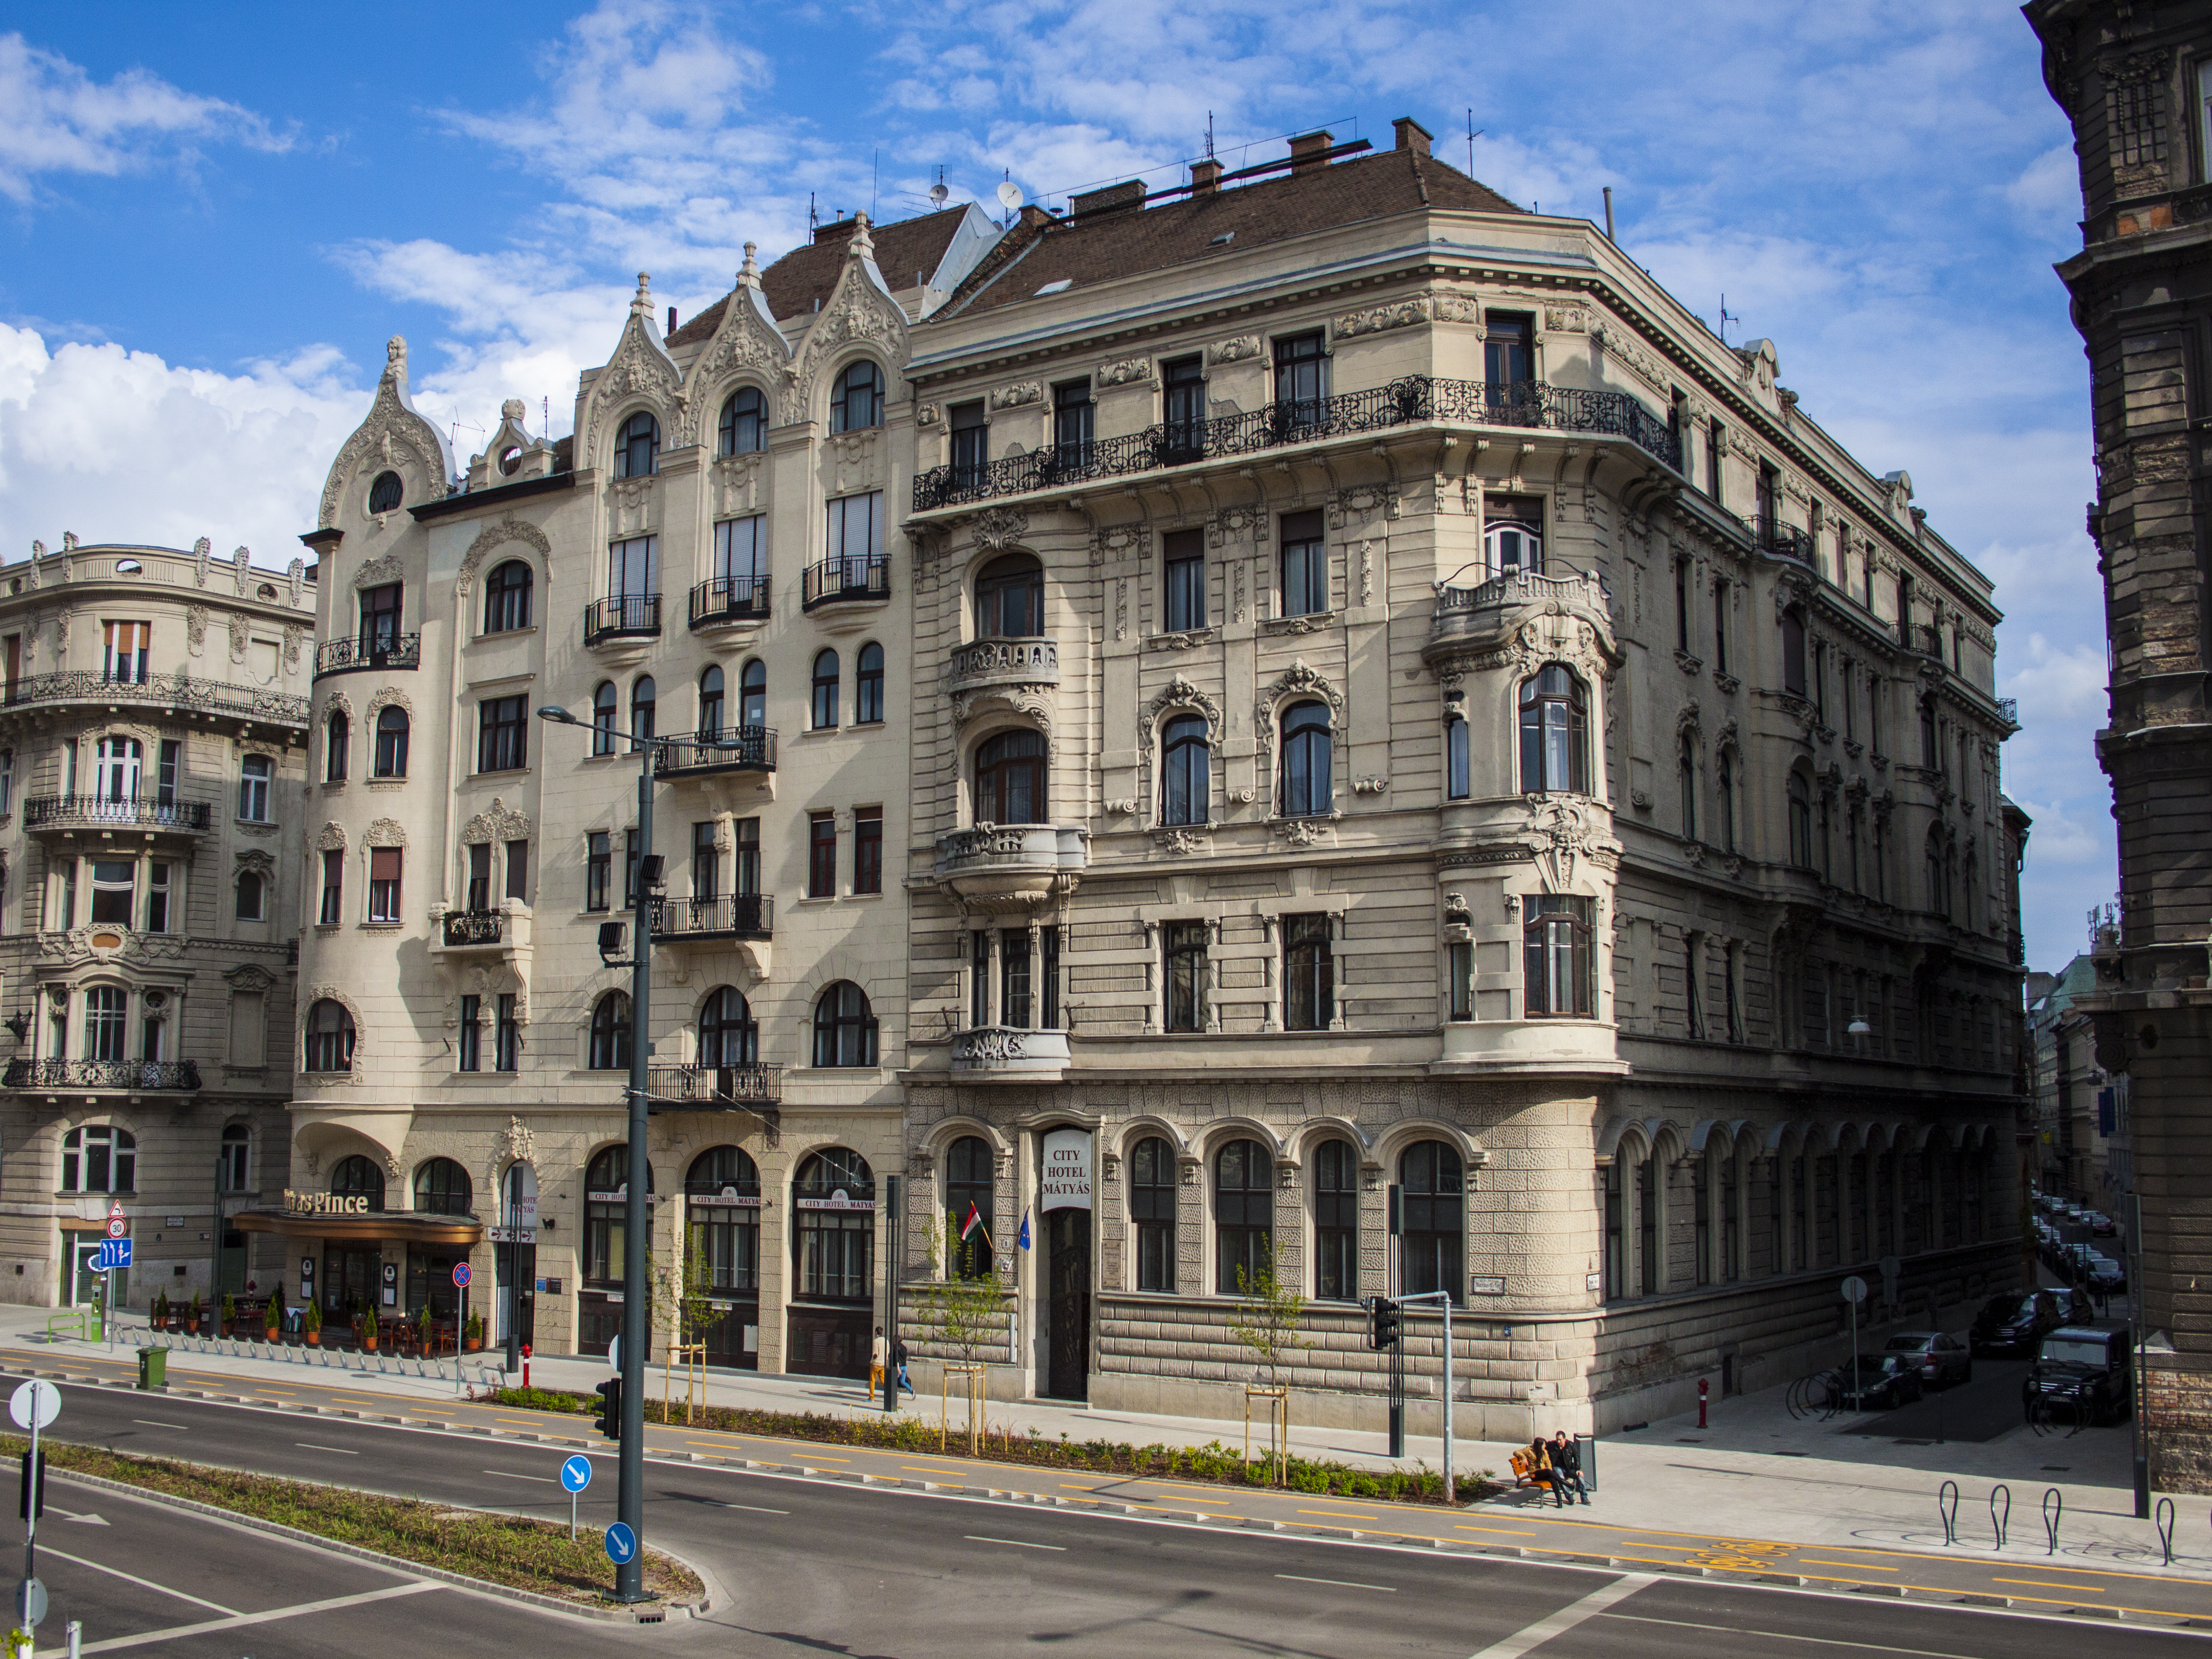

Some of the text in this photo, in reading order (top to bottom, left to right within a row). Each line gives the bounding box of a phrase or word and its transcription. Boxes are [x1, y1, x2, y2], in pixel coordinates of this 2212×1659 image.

[1053, 1150, 1080, 1160] CITY
[1047, 1167, 1086, 1177] HOTEL
[1043, 1180, 1090, 1194] MÁTYÁS
[315, 1191, 368, 1213] Pince
[113, 1224, 121, 1233] 30
